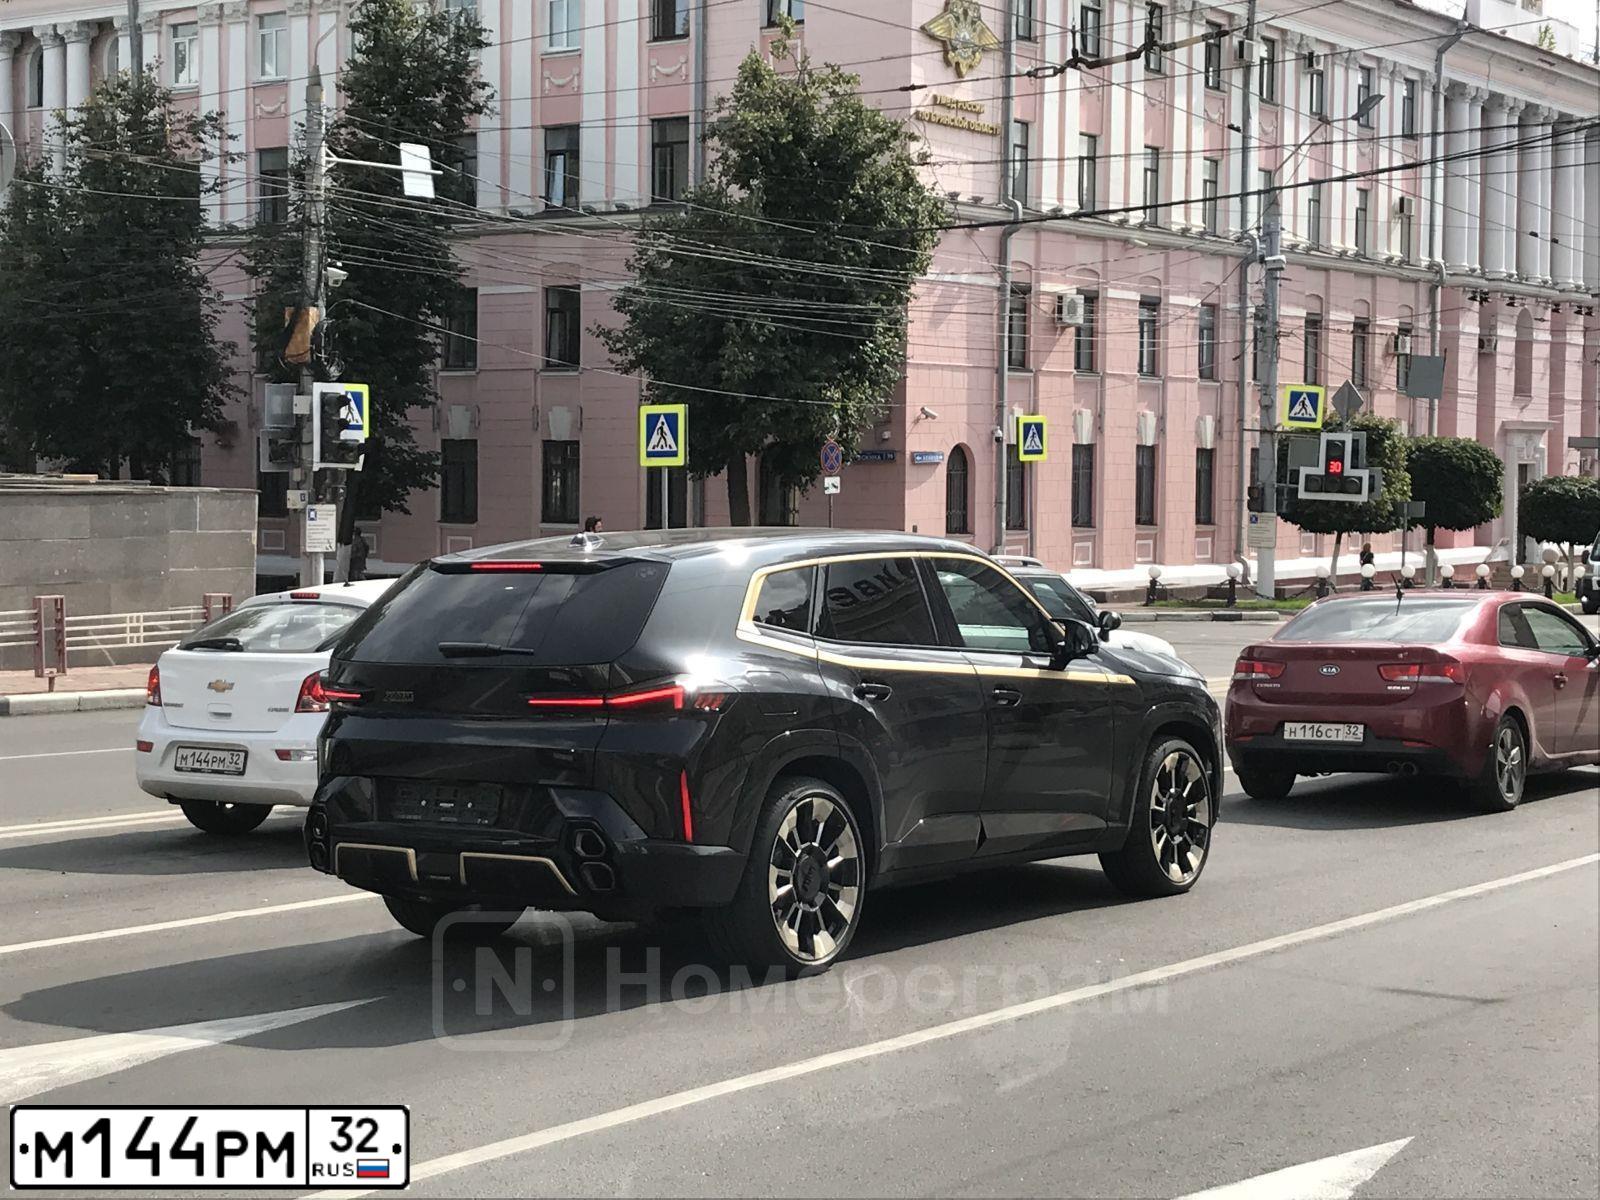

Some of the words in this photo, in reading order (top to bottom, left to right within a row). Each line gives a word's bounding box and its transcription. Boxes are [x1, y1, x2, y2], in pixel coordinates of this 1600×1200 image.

[1329, 460, 1342, 473] 30
[1289, 724, 1341, 738] Н116СТ
[1345, 724, 1359, 736] 32
[180, 751, 226, 768] М144РМ
[228, 752, 241, 765] 32
